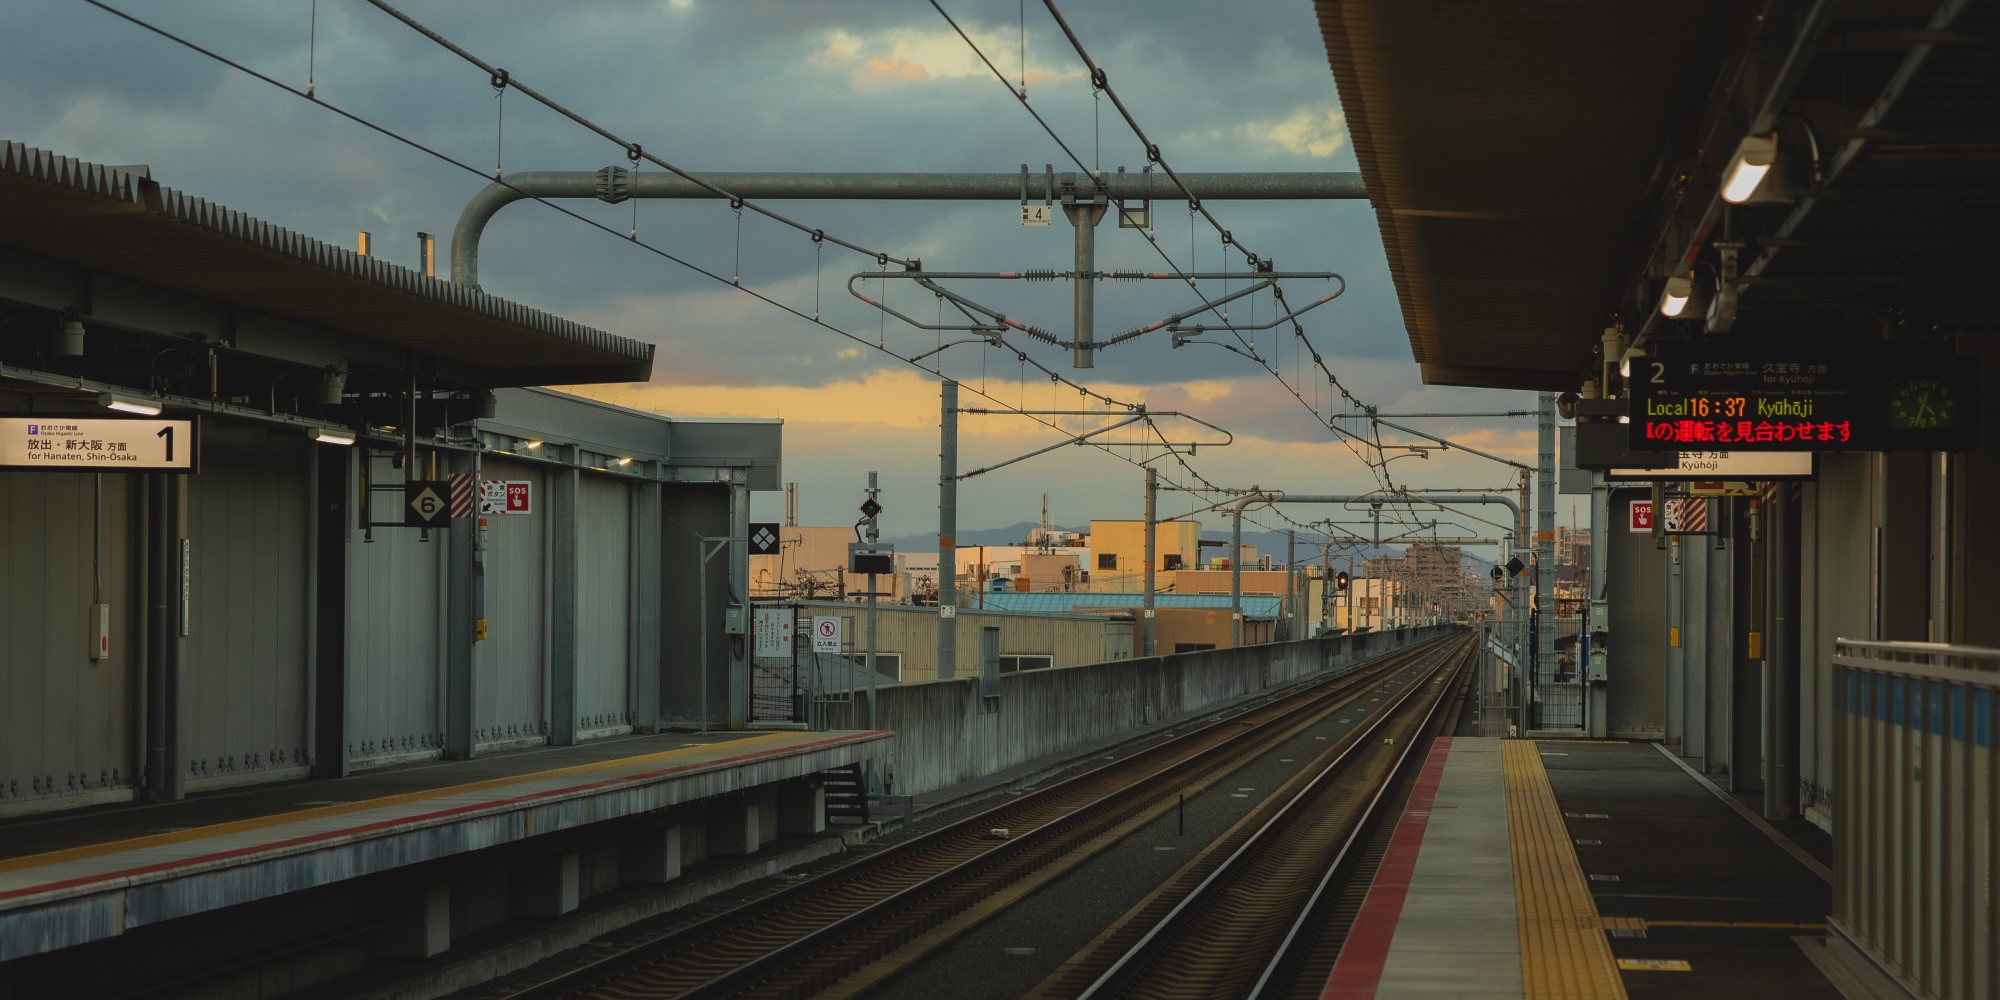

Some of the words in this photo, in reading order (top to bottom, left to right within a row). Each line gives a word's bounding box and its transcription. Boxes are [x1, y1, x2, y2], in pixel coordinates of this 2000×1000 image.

[1036, 207, 1042, 219] 4
[1650, 362, 1665, 383] 2
[1690, 364, 1699, 375] F
[1763, 362, 1801, 374] 久宝寺
[1808, 364, 1828, 374] 方面
[1763, 375, 1777, 383] for
[1647, 398, 1688, 416] Local
[1690, 398, 1746, 417] 16:37
[1758, 398, 1813, 418] Kyūhōji
[29, 425, 37, 434] F
[28, 439, 103, 451] 放出・新大阪
[107, 442, 127, 451] 方面
[157, 426, 174, 462] 1
[28, 452, 41, 460] for
[43, 452, 85, 461] Hanaten,
[86, 452, 137, 461] Shin-Ōsaka
[508, 487, 527, 495] SOS
[420, 497, 436, 513] 6
[1634, 506, 1652, 514] SOS
